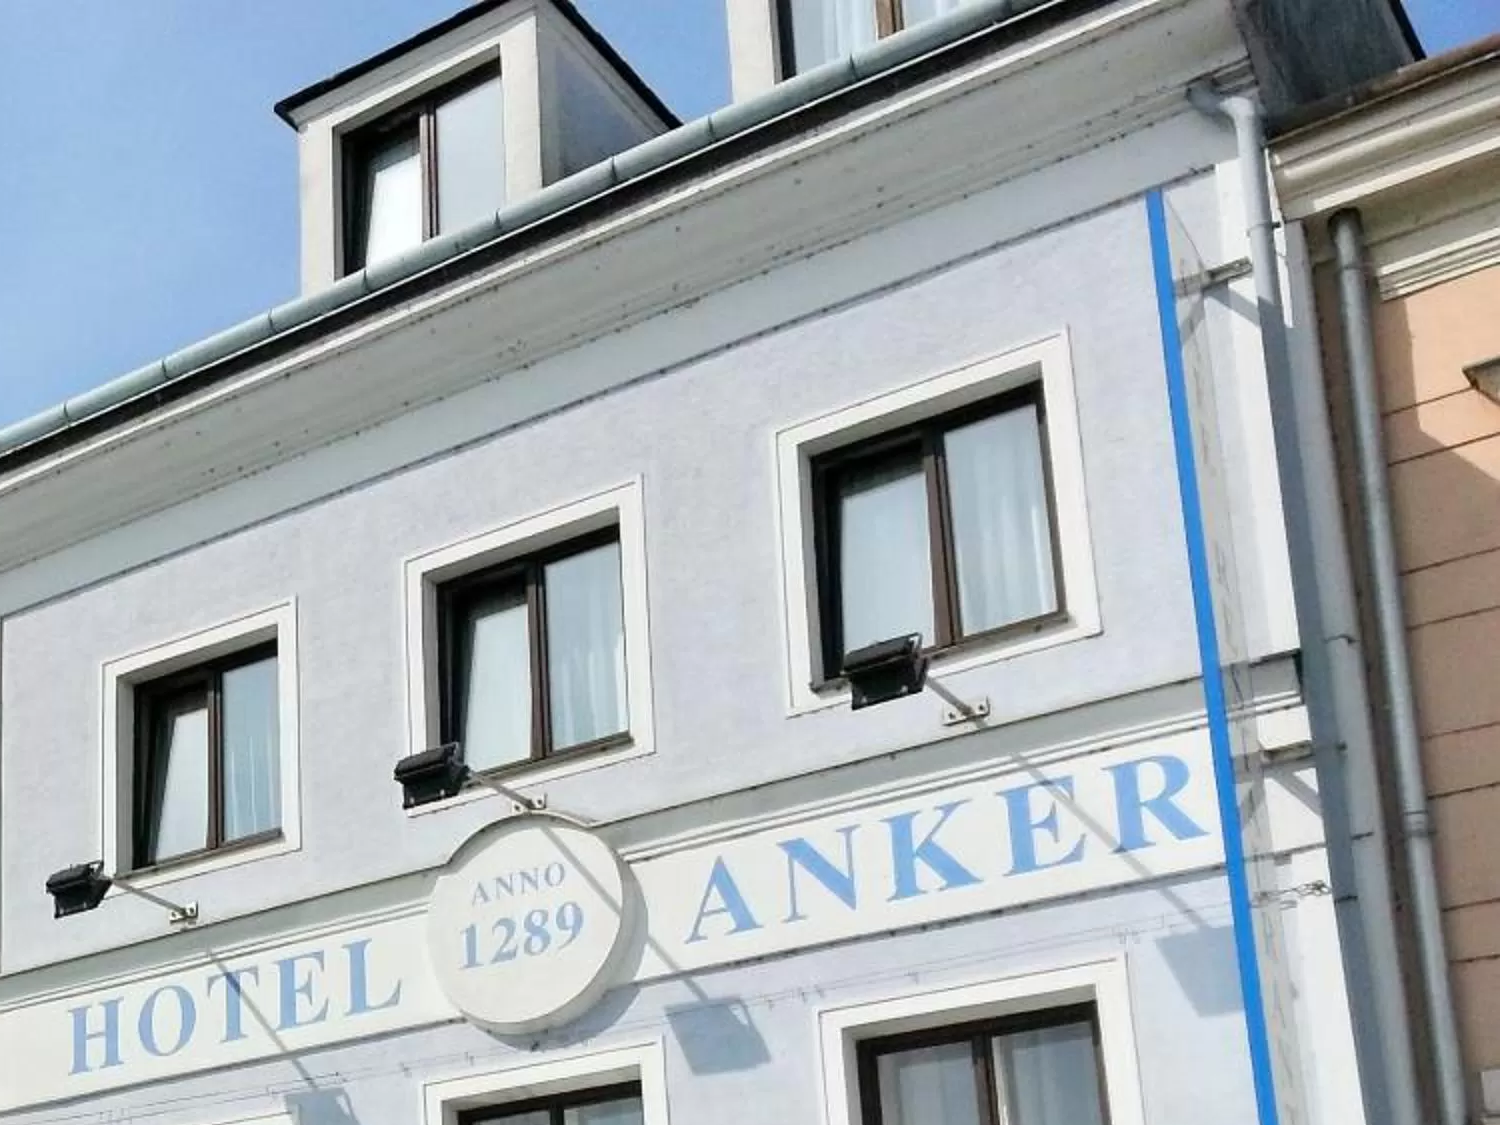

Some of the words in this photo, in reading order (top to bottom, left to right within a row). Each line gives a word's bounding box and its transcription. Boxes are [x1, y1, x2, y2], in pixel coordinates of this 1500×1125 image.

[68, 938, 401, 1075] HOTEL
[683, 755, 1211, 944] ANKER
[472, 862, 565, 906] ANNO
[459, 901, 584, 969] 1289
